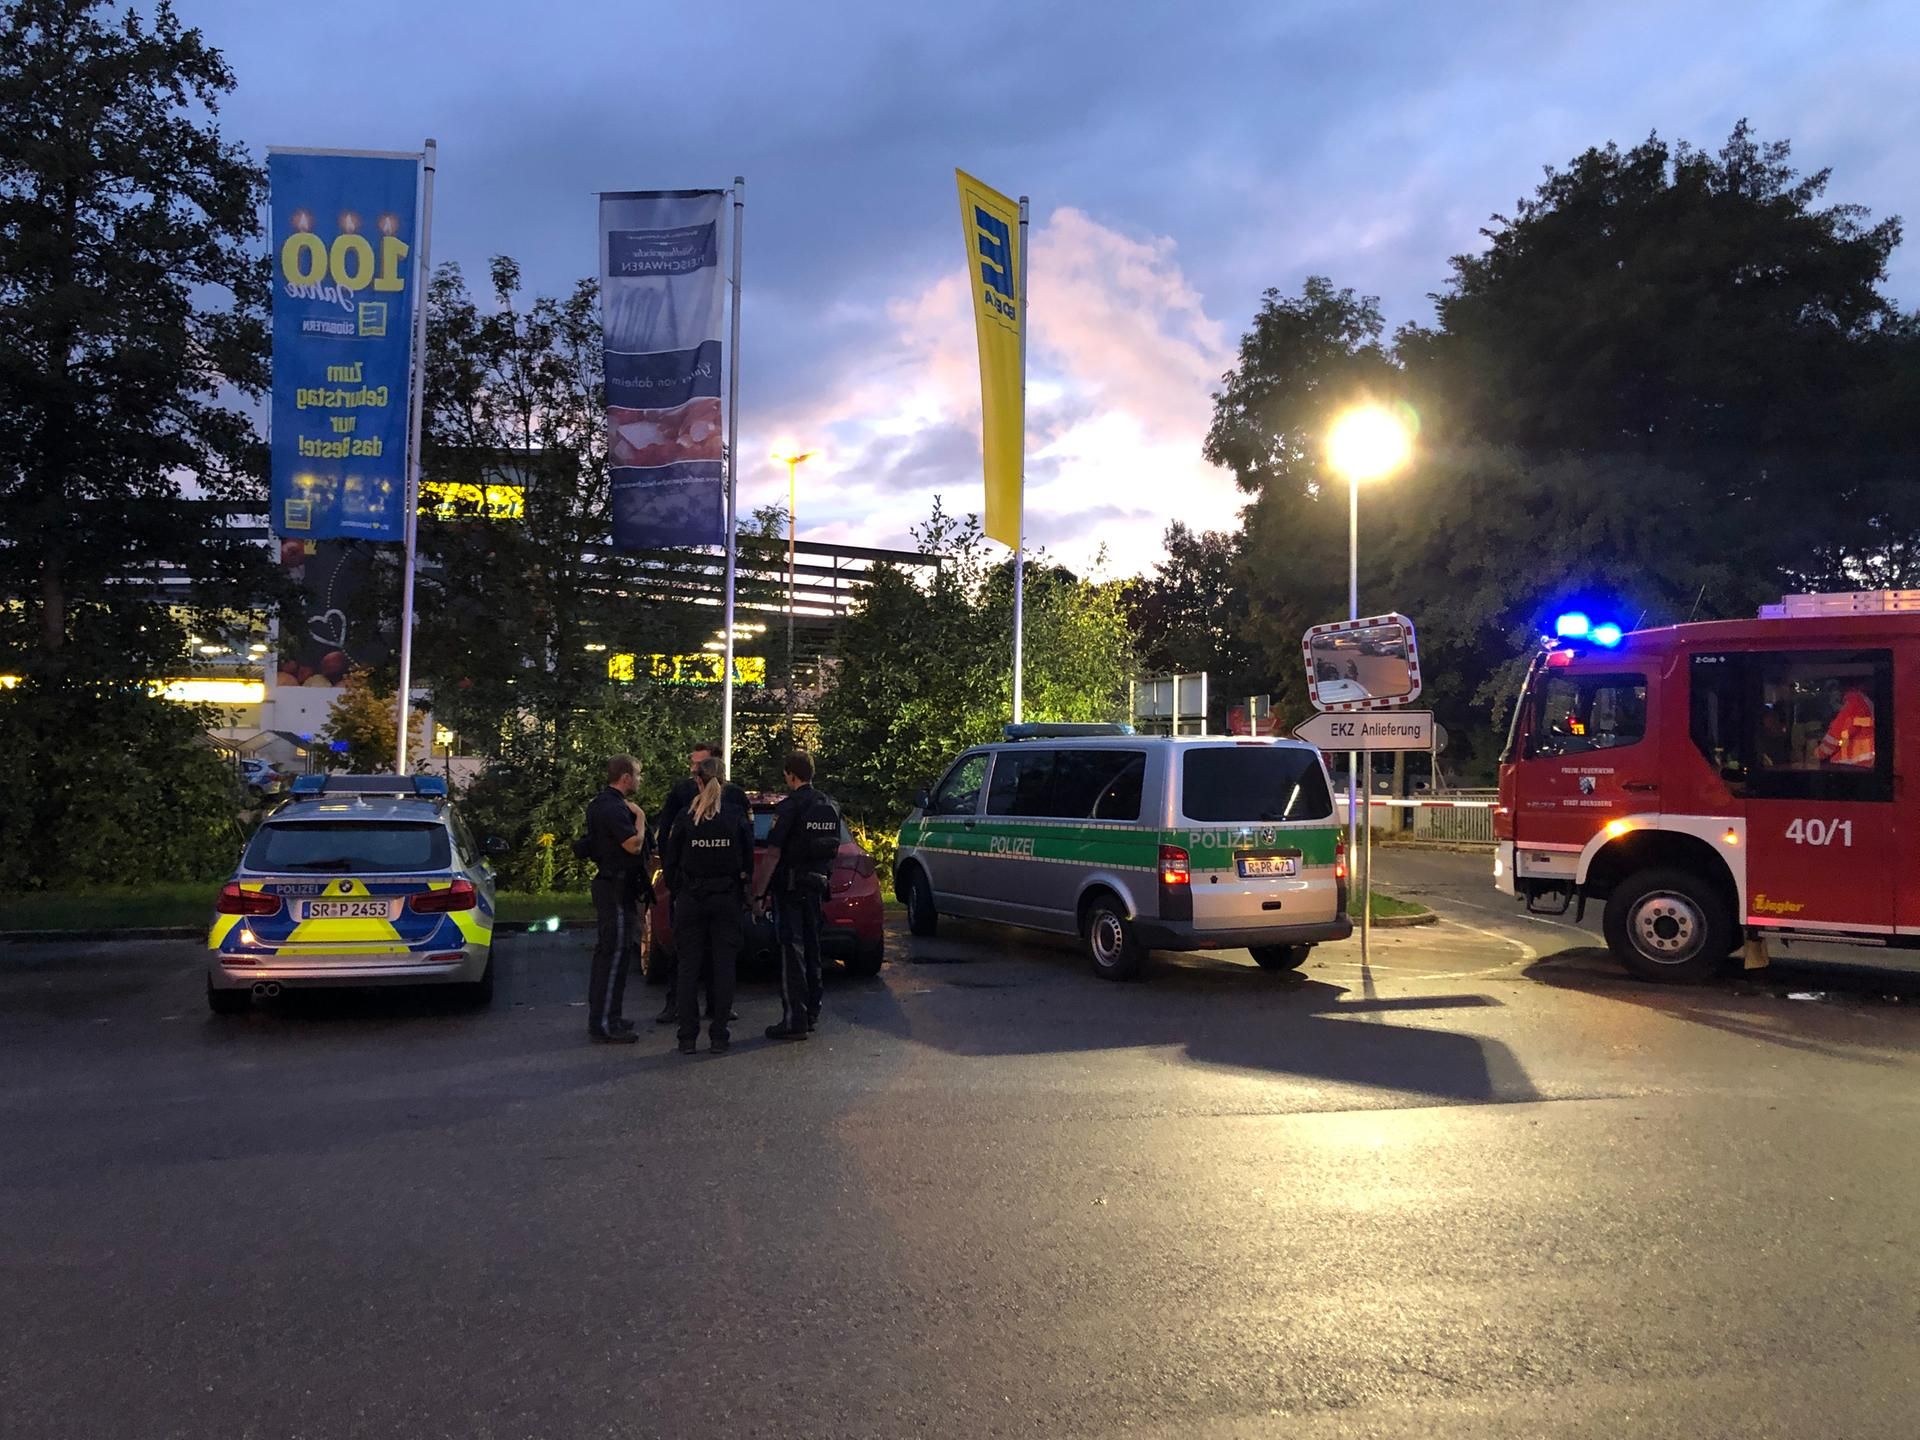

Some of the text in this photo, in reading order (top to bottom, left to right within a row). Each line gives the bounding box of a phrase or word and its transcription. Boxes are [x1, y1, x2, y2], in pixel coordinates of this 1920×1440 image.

[1331, 723, 1421, 739] EKZ Anlieferung
[806, 821, 836, 830] POLIZEI
[1785, 818, 1853, 847] 40/1
[691, 838, 731, 848] POLIZEI
[990, 836, 1035, 856] POLIZEI
[1189, 833, 1259, 848] POLIZEI
[1248, 861, 1291, 872] R PR 471
[276, 884, 319, 895] POLIZEI
[311, 902, 387, 917] SR P 2453
